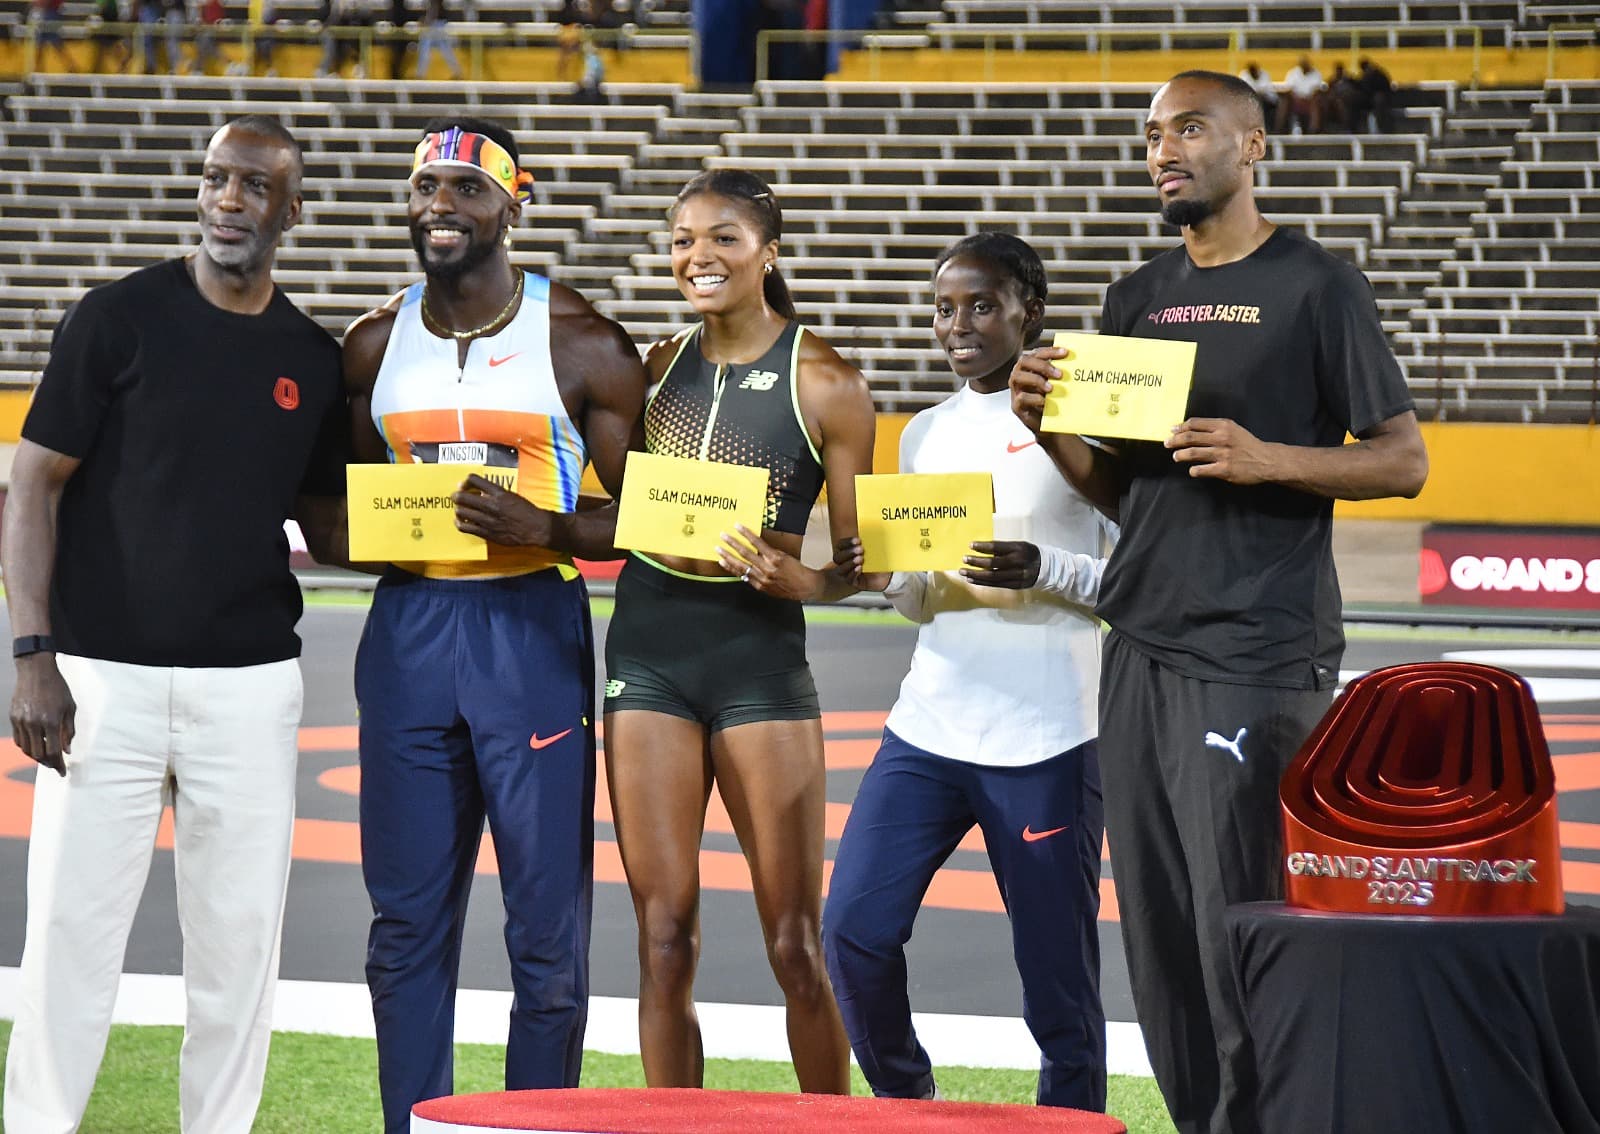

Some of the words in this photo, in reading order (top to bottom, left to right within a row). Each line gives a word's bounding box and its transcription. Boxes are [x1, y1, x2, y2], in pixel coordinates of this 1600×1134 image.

[1074, 368, 1104, 383] SLAM
[1105, 371, 1162, 387] CHAMPION
[441, 446, 484, 461] KINGSTON
[373, 497, 402, 509] SLAM
[648, 488, 679, 503] SLAM
[680, 491, 738, 511] CHAMPION
[881, 507, 910, 520] SLAM
[912, 505, 967, 519] CHAMPION
[1450, 555, 1584, 592] GRAND
[1287, 852, 1370, 879] GRAND
[1371, 855, 1438, 881] SLAM
[1438, 858, 1538, 883] TRACK
[1367, 881, 1434, 906] 2025
